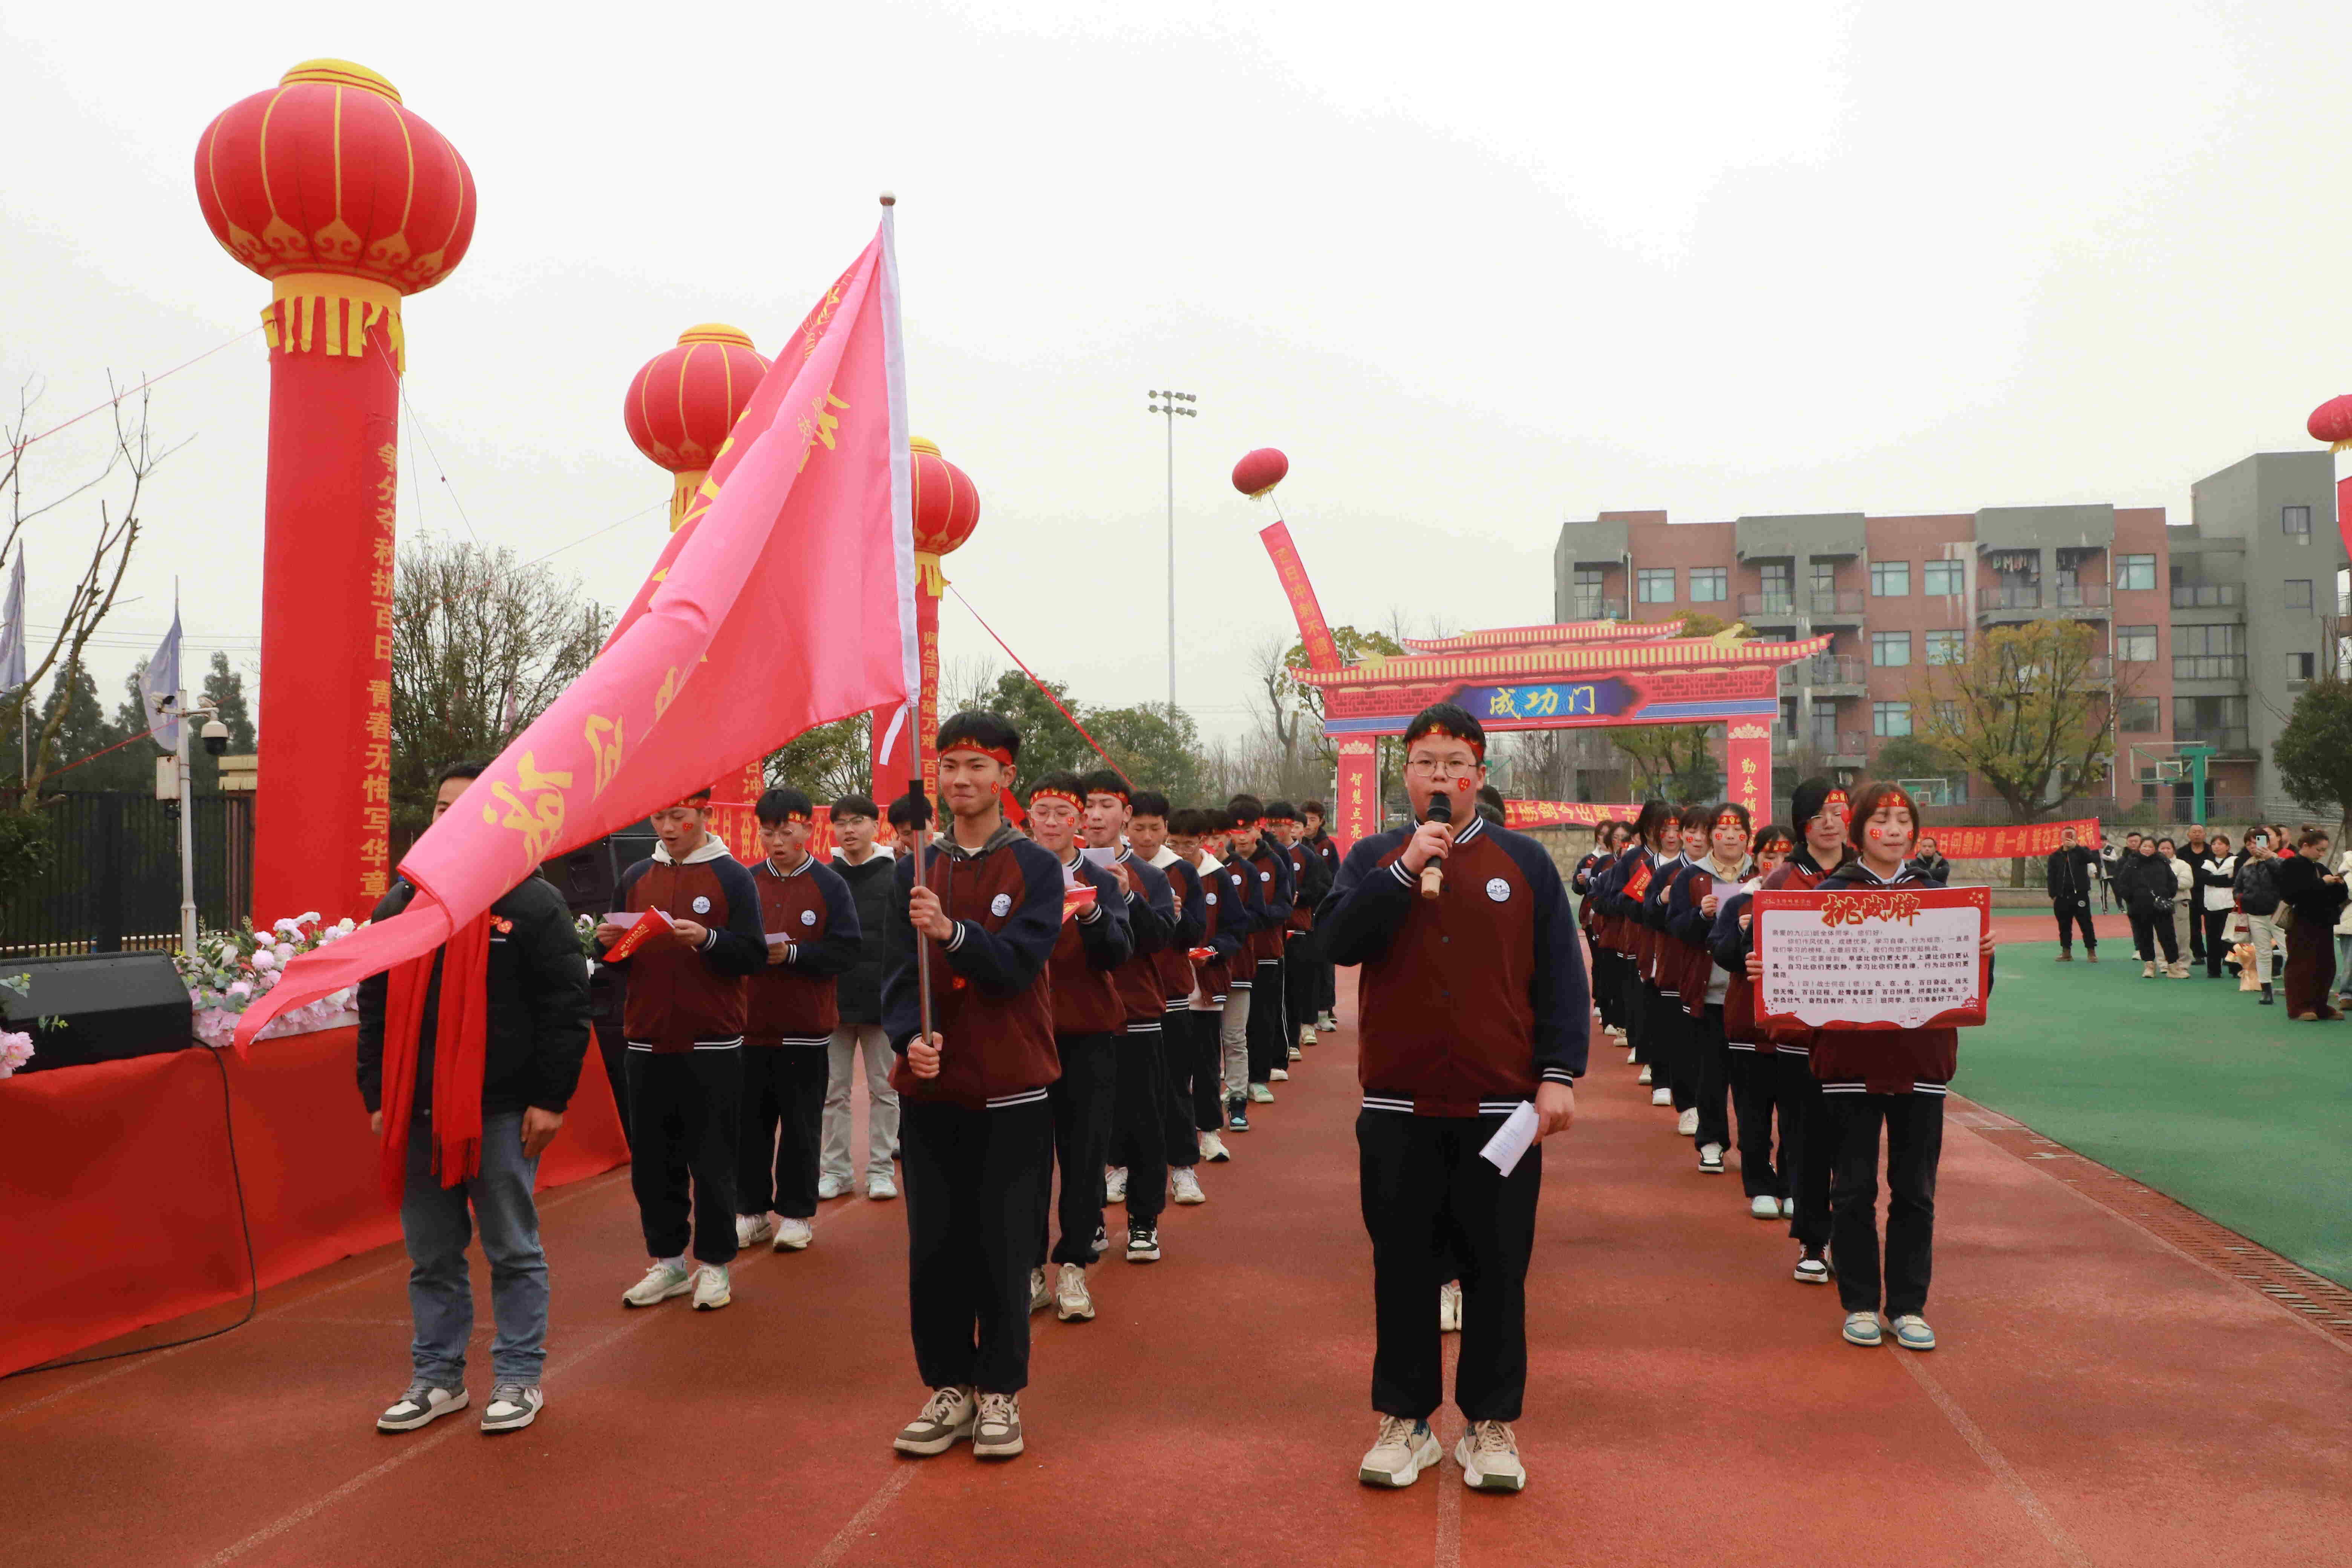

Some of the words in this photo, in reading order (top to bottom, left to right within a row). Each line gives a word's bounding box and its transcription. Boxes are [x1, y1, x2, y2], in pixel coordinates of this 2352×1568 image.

[921, 631, 938, 749] 师生同心破万难
[1490, 685, 1595, 720] 成功门
[360, 679, 391, 899] 青春无悔写华章
[1349, 772, 1364, 850] 智慧点亮
[1821, 894, 1921, 928] 挑战牌
